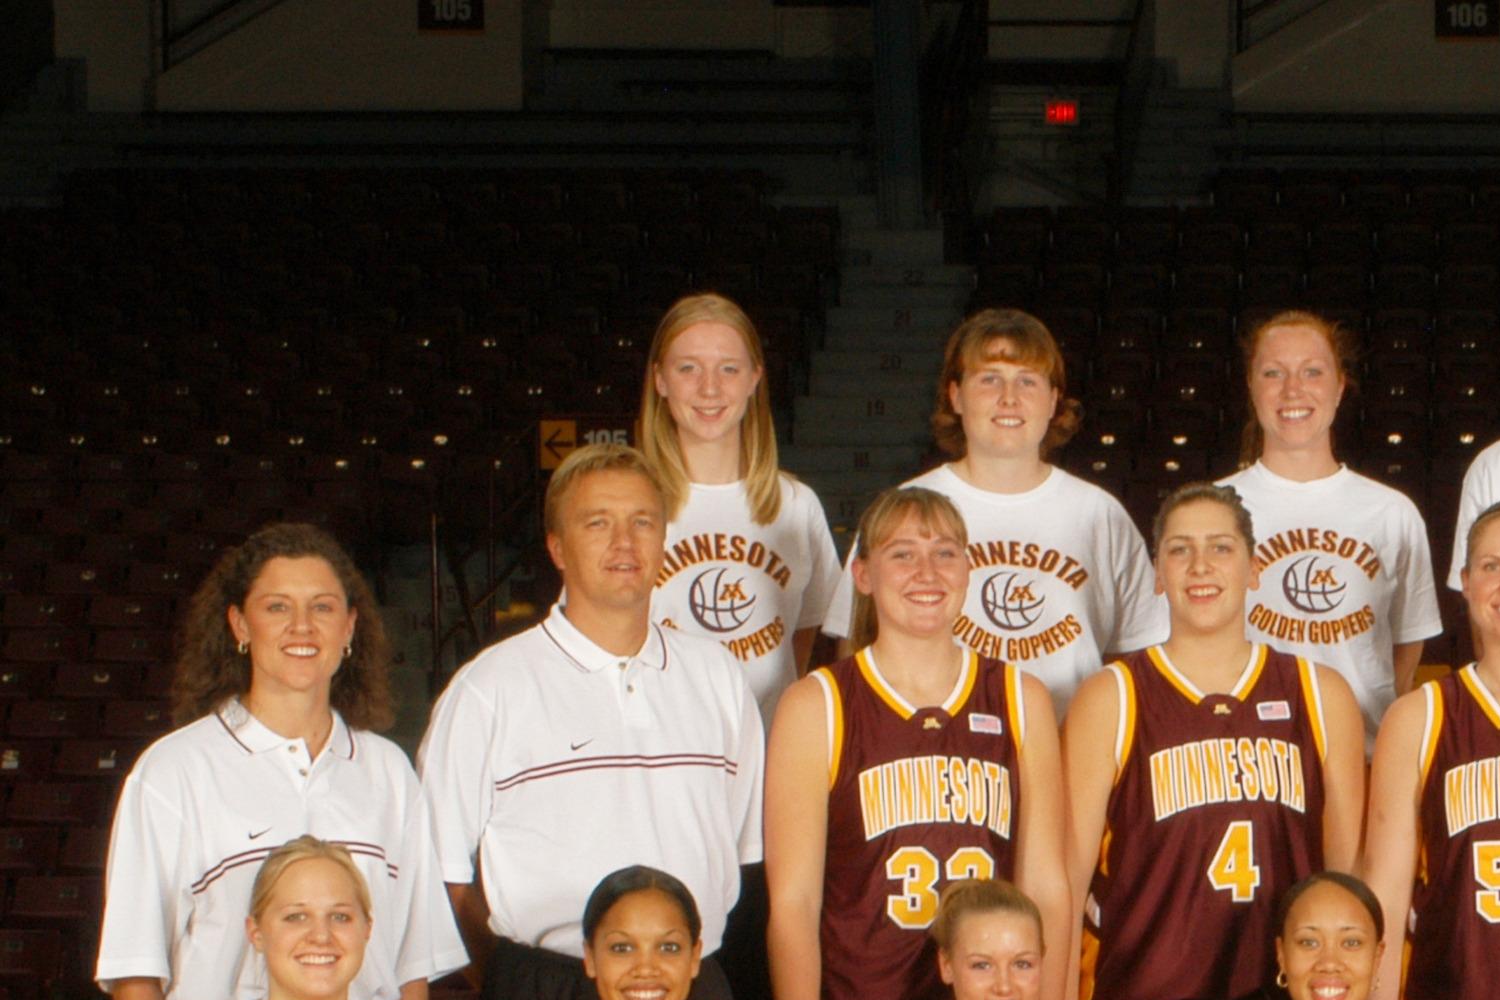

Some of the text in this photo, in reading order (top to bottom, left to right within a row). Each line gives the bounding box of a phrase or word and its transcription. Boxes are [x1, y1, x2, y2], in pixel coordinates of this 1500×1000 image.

[432, 0, 472, 20] 105
[1447, 3, 1488, 28] 106
[967, 541, 1089, 590] NNESOTA
[720, 615, 784, 662] OPHERS
[951, 613, 1083, 662] OLDEN GOPHERS
[1248, 603, 1377, 645] GOLDEN GOPHERS
[859, 755, 1011, 841] MINNESOTA
[1150, 737, 1306, 822] MINNESOTA
[1207, 820, 1260, 902] 4
